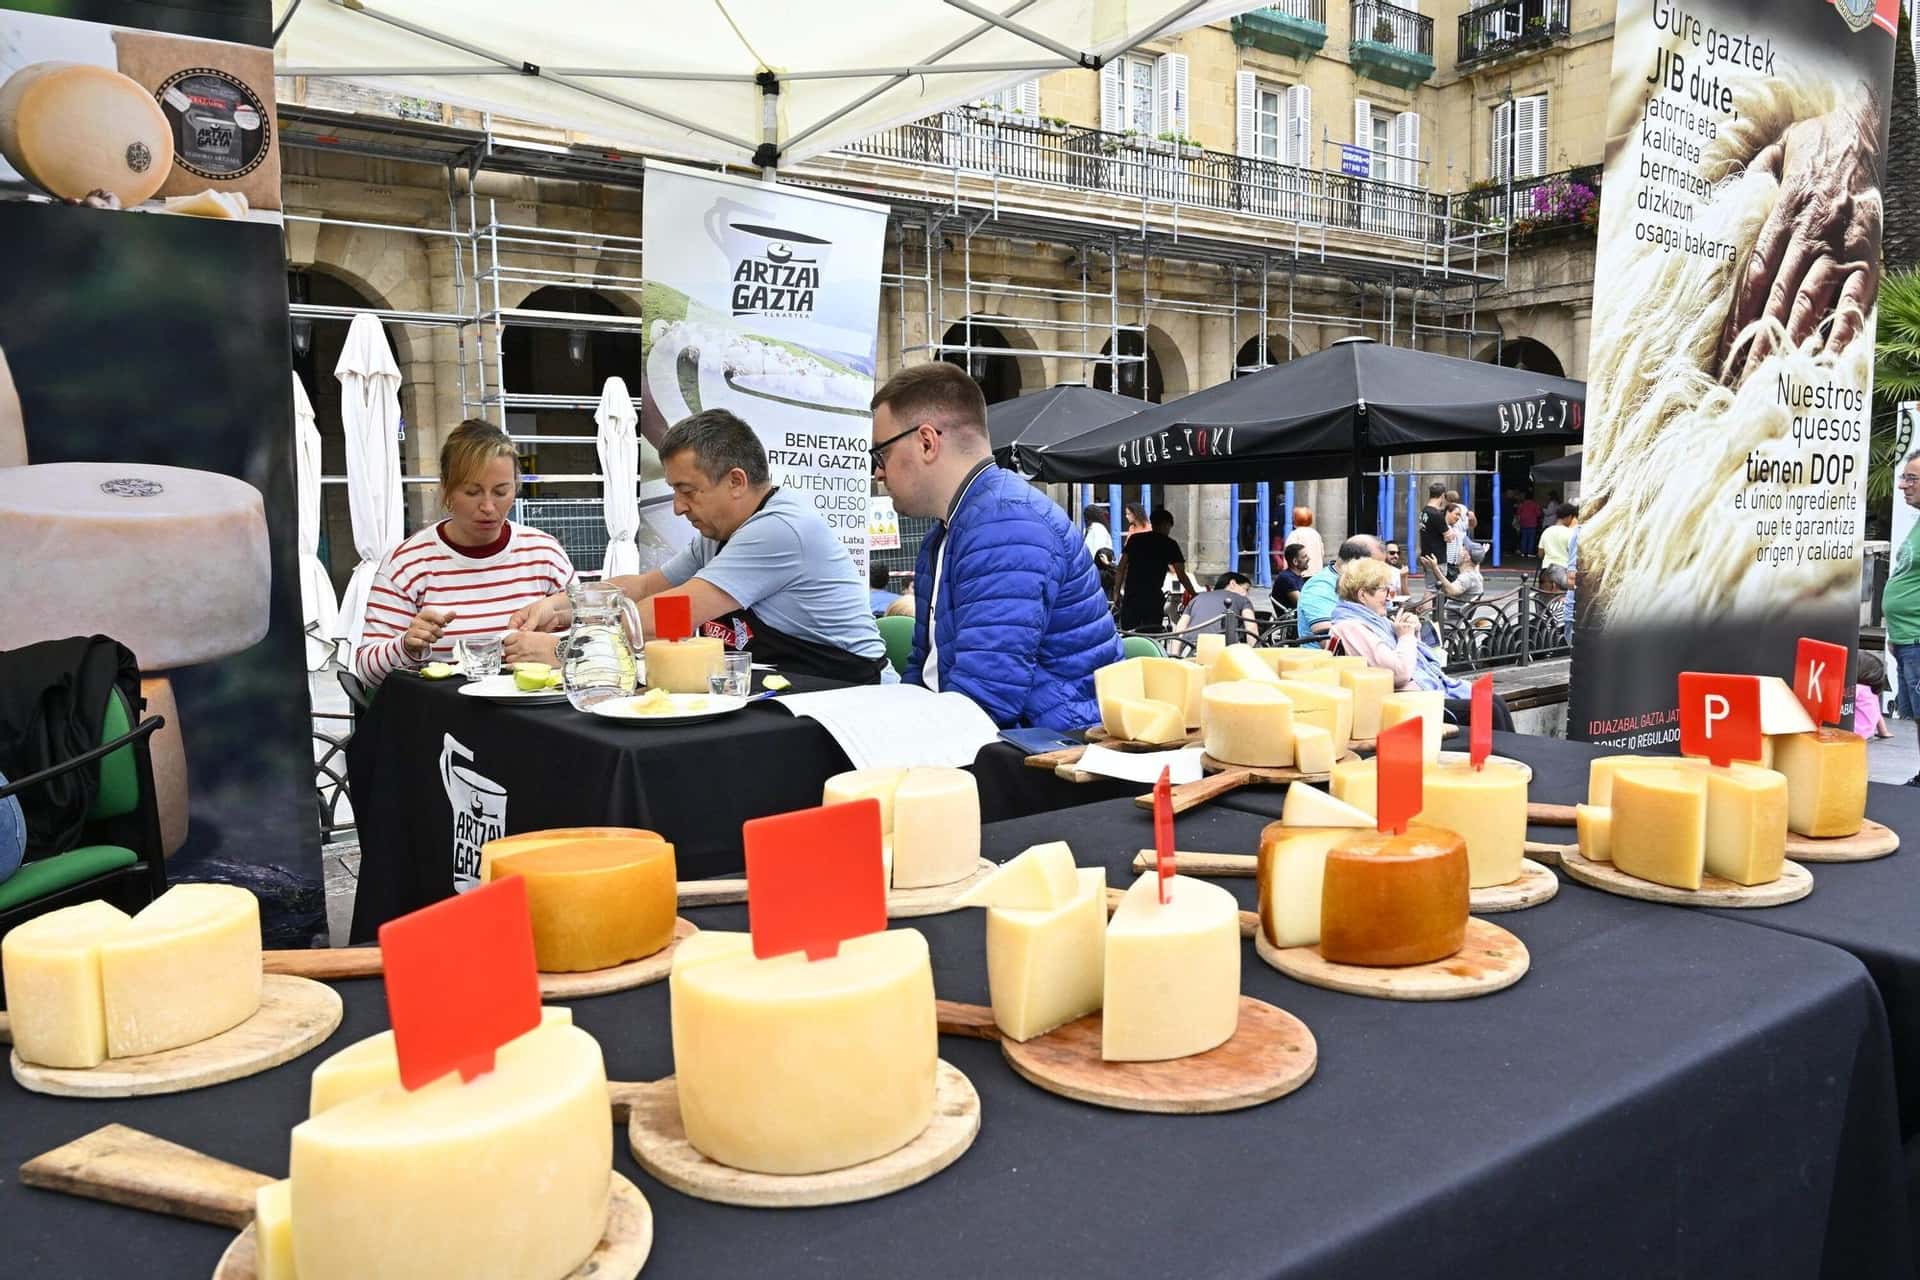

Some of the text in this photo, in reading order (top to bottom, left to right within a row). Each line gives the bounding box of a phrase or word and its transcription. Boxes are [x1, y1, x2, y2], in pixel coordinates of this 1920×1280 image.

[1653, 0, 1776, 77] Gure gaztek
[1646, 47, 1738, 121] JIB dute,
[1642, 89, 1717, 140] jatorria eta
[1642, 122, 1700, 164] kalitatea
[1640, 152, 1712, 199] bermatzen
[1637, 185, 1694, 223] dizkizun
[1635, 222, 1737, 262] osagai bakarra
[733, 259, 820, 289] ARTZAI
[732, 284, 814, 311] GAZTA
[1777, 372, 1863, 412] Nuestros
[1498, 399, 1581, 434] GURE-TO
[1792, 416, 1861, 449] quesos
[785, 432, 868, 453] BENETAKO
[768, 450, 867, 471] RTZAI GAZTA
[1746, 450, 1857, 490] tienen DOP,
[782, 473, 867, 493] AUTÉNTICO
[814, 494, 866, 511] QUESO
[1735, 488, 1857, 516] el único ingrediente
[826, 513, 866, 529] STOR
[1756, 516, 1855, 541] que te garantiza
[843, 535, 865, 545] Latxa
[1756, 540, 1854, 568] origen y calidad
[1807, 659, 1826, 704] K
[1589, 708, 1680, 736] IDIAZABAL GAZTA JAT
[1704, 693, 1731, 739] P
[1637, 728, 1680, 748] REGULADO
[454, 842, 482, 879] GAZ
